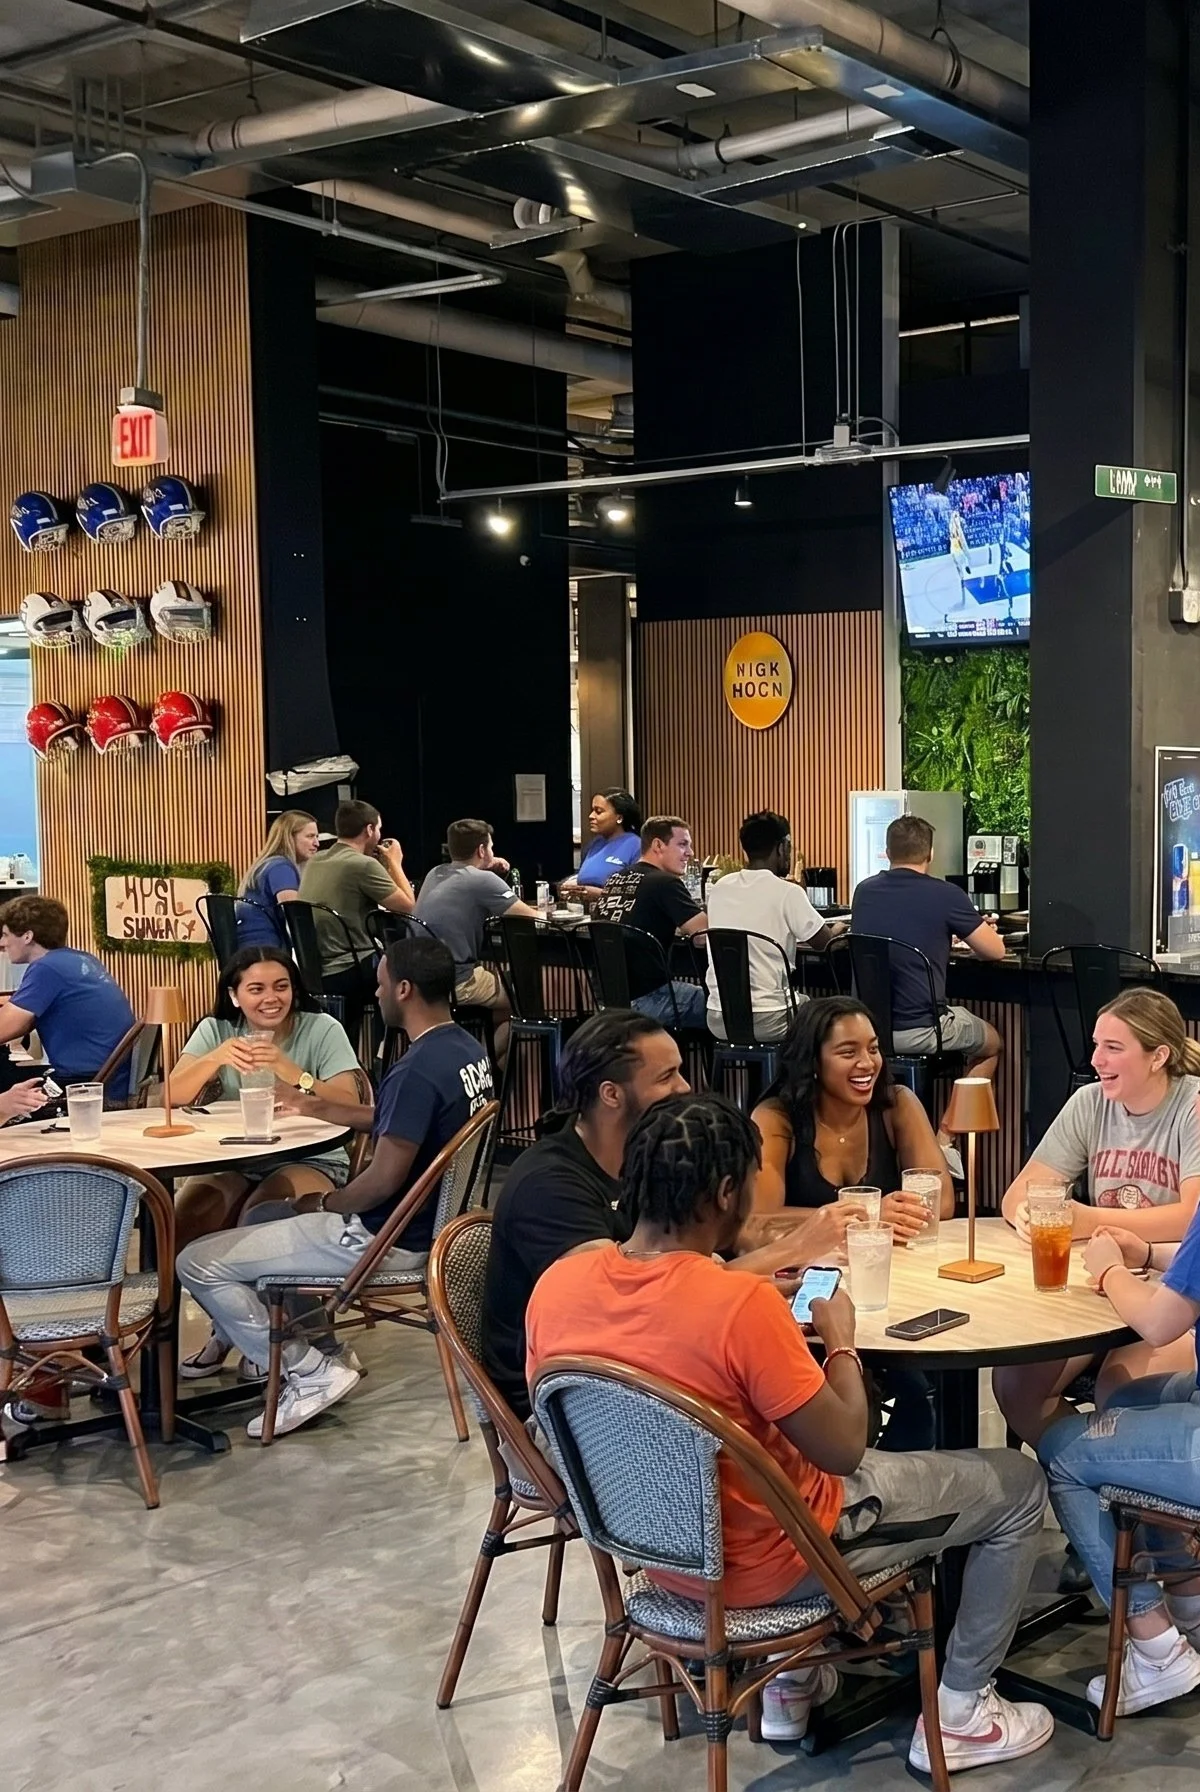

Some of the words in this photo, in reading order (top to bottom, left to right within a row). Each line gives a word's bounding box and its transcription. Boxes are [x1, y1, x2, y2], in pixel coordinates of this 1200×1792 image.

[120, 414, 153, 459] EXIT
[736, 661, 780, 678] NIGK
[732, 681, 783, 699] HOCN
